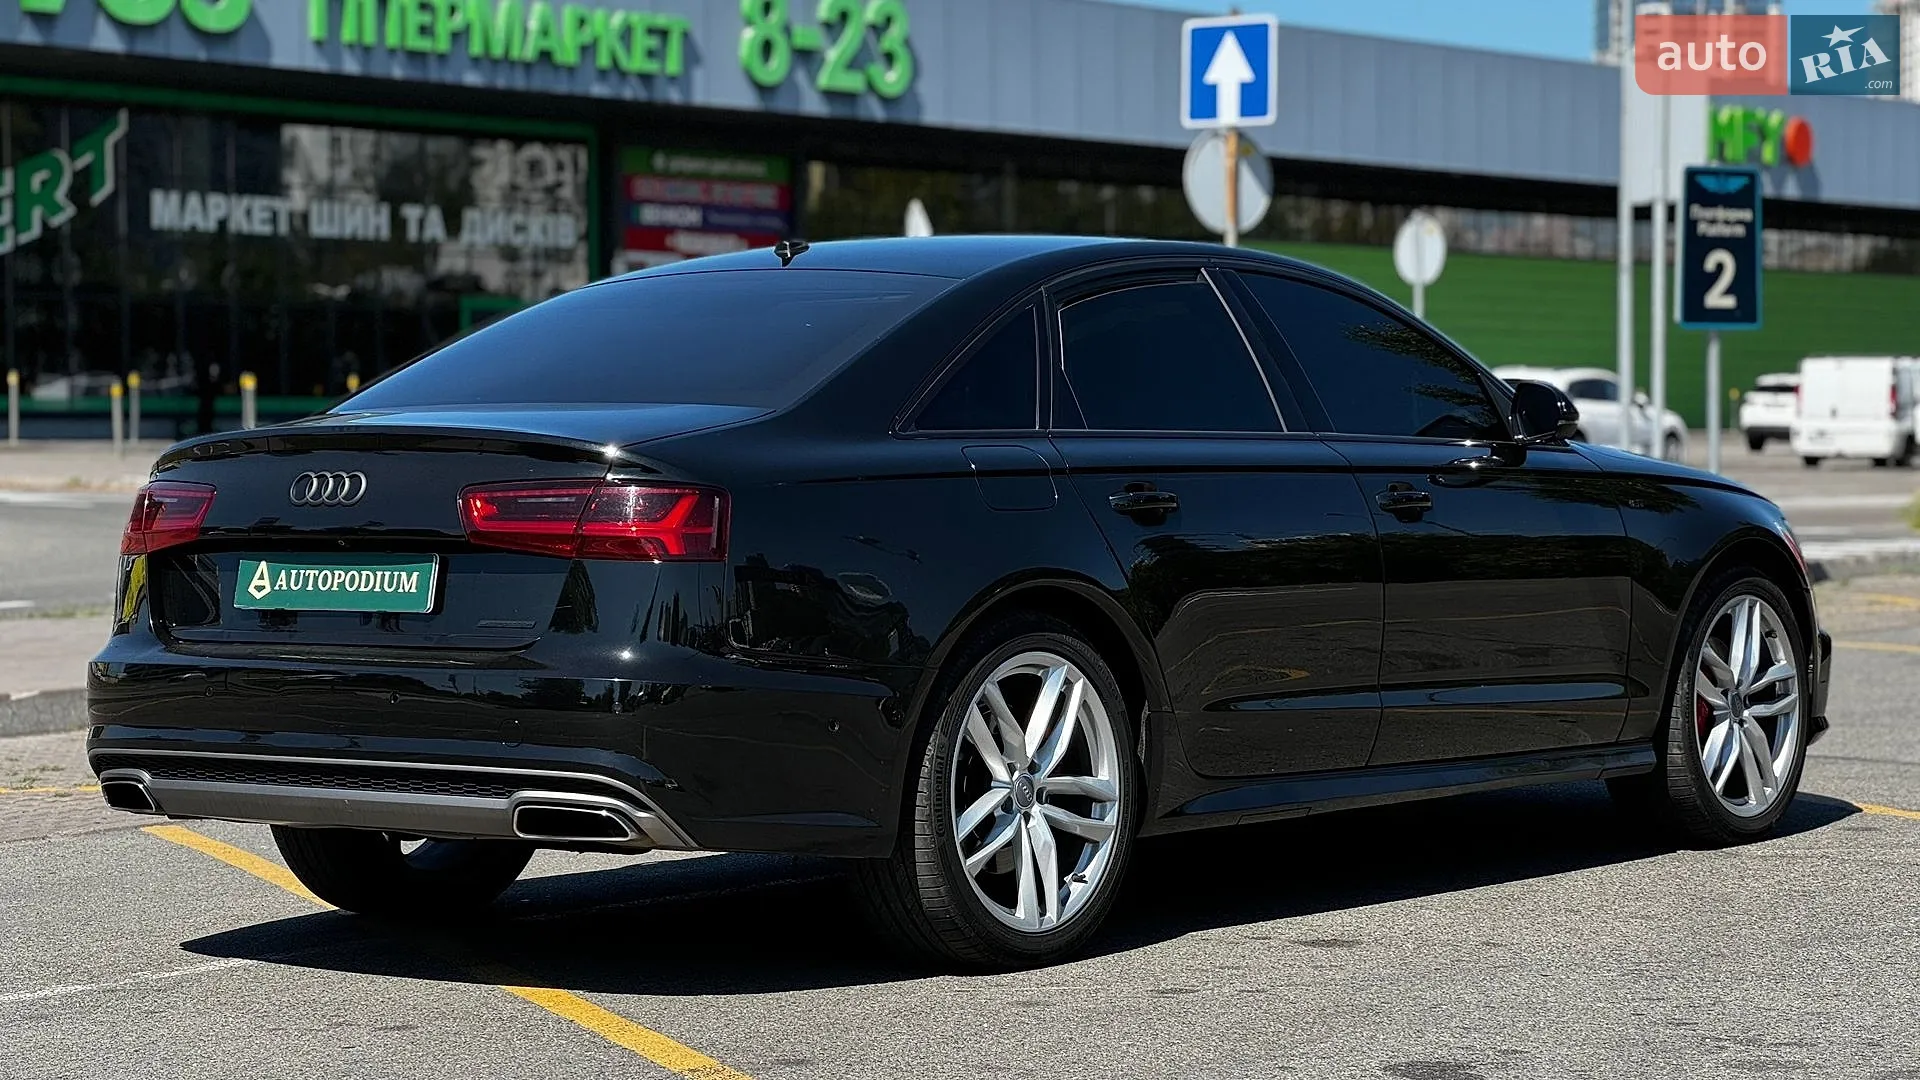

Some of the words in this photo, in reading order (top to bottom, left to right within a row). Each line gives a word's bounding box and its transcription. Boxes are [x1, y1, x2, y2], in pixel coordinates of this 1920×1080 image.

[739, 0, 913, 98] 8-23
[150, 188, 290, 237] МАРКЕТ
[309, 200, 390, 242] ШИН
[401, 203, 446, 245] ТА
[459, 207, 579, 250] ДИСКІВ
[1702, 247, 1738, 310] 2
[274, 569, 420, 593] AUTOPODIUM
